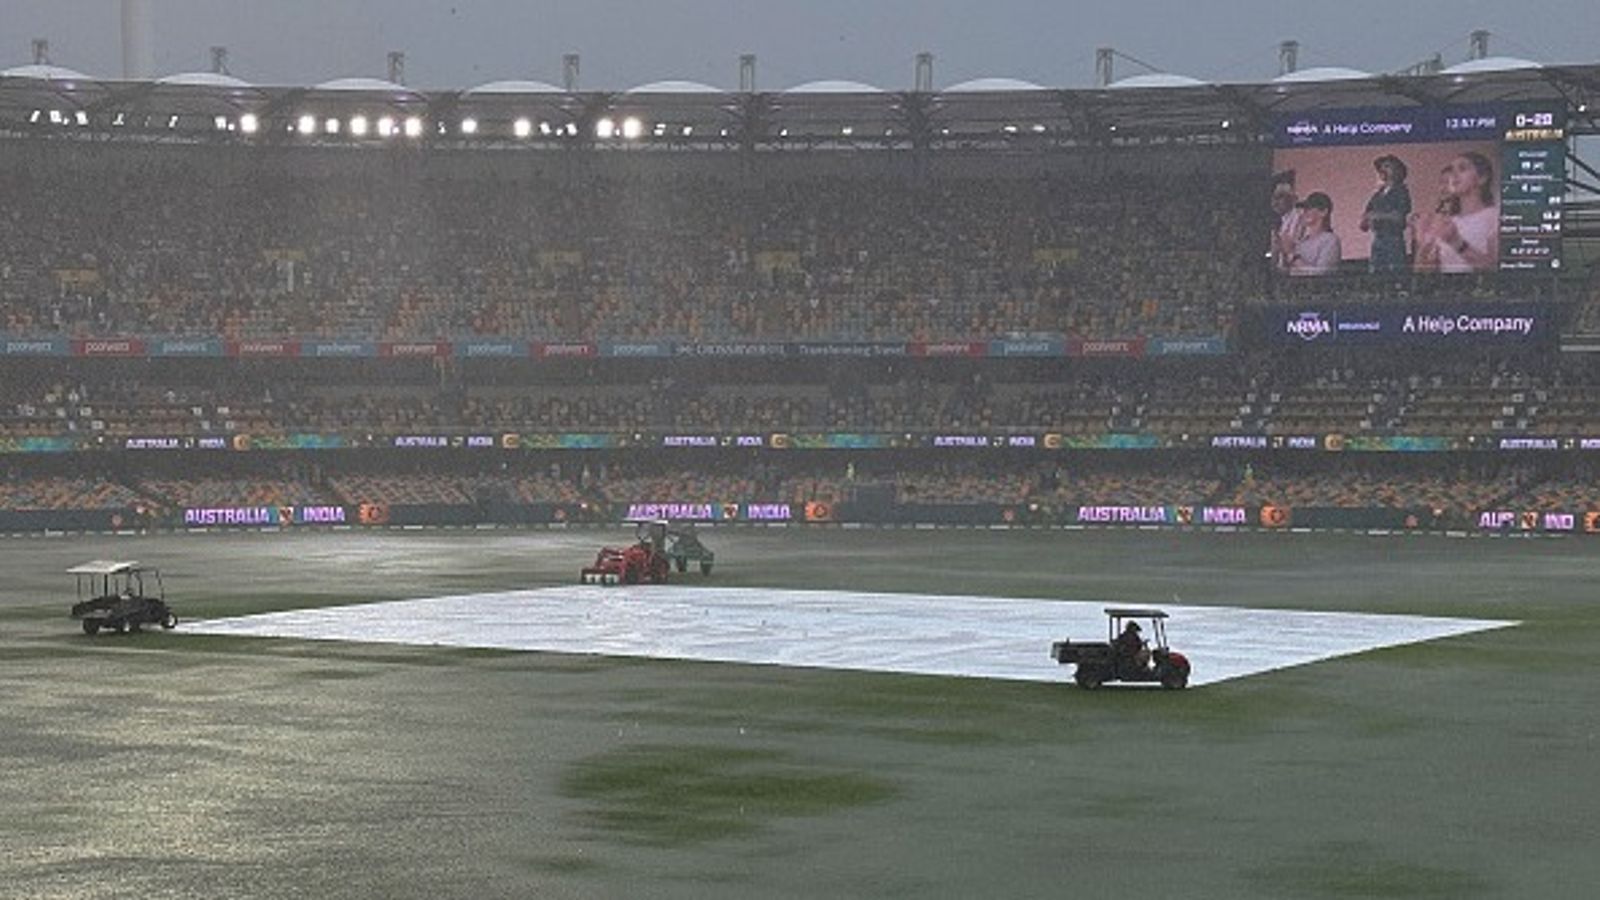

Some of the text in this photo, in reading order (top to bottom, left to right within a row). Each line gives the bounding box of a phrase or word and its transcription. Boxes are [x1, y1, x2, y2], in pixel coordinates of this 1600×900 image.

[1360, 121, 1412, 134] Company
[1287, 319, 1331, 334] NRMA
[1402, 316, 1415, 332] A
[1419, 315, 1456, 335] Help
[1457, 315, 1534, 335] Company
[184, 506, 346, 524] AUSTRALIA INDIA
[628, 503, 792, 519] AUSTRALIA INDIA
[1077, 505, 1247, 524] AUSTRALIA INDIA
